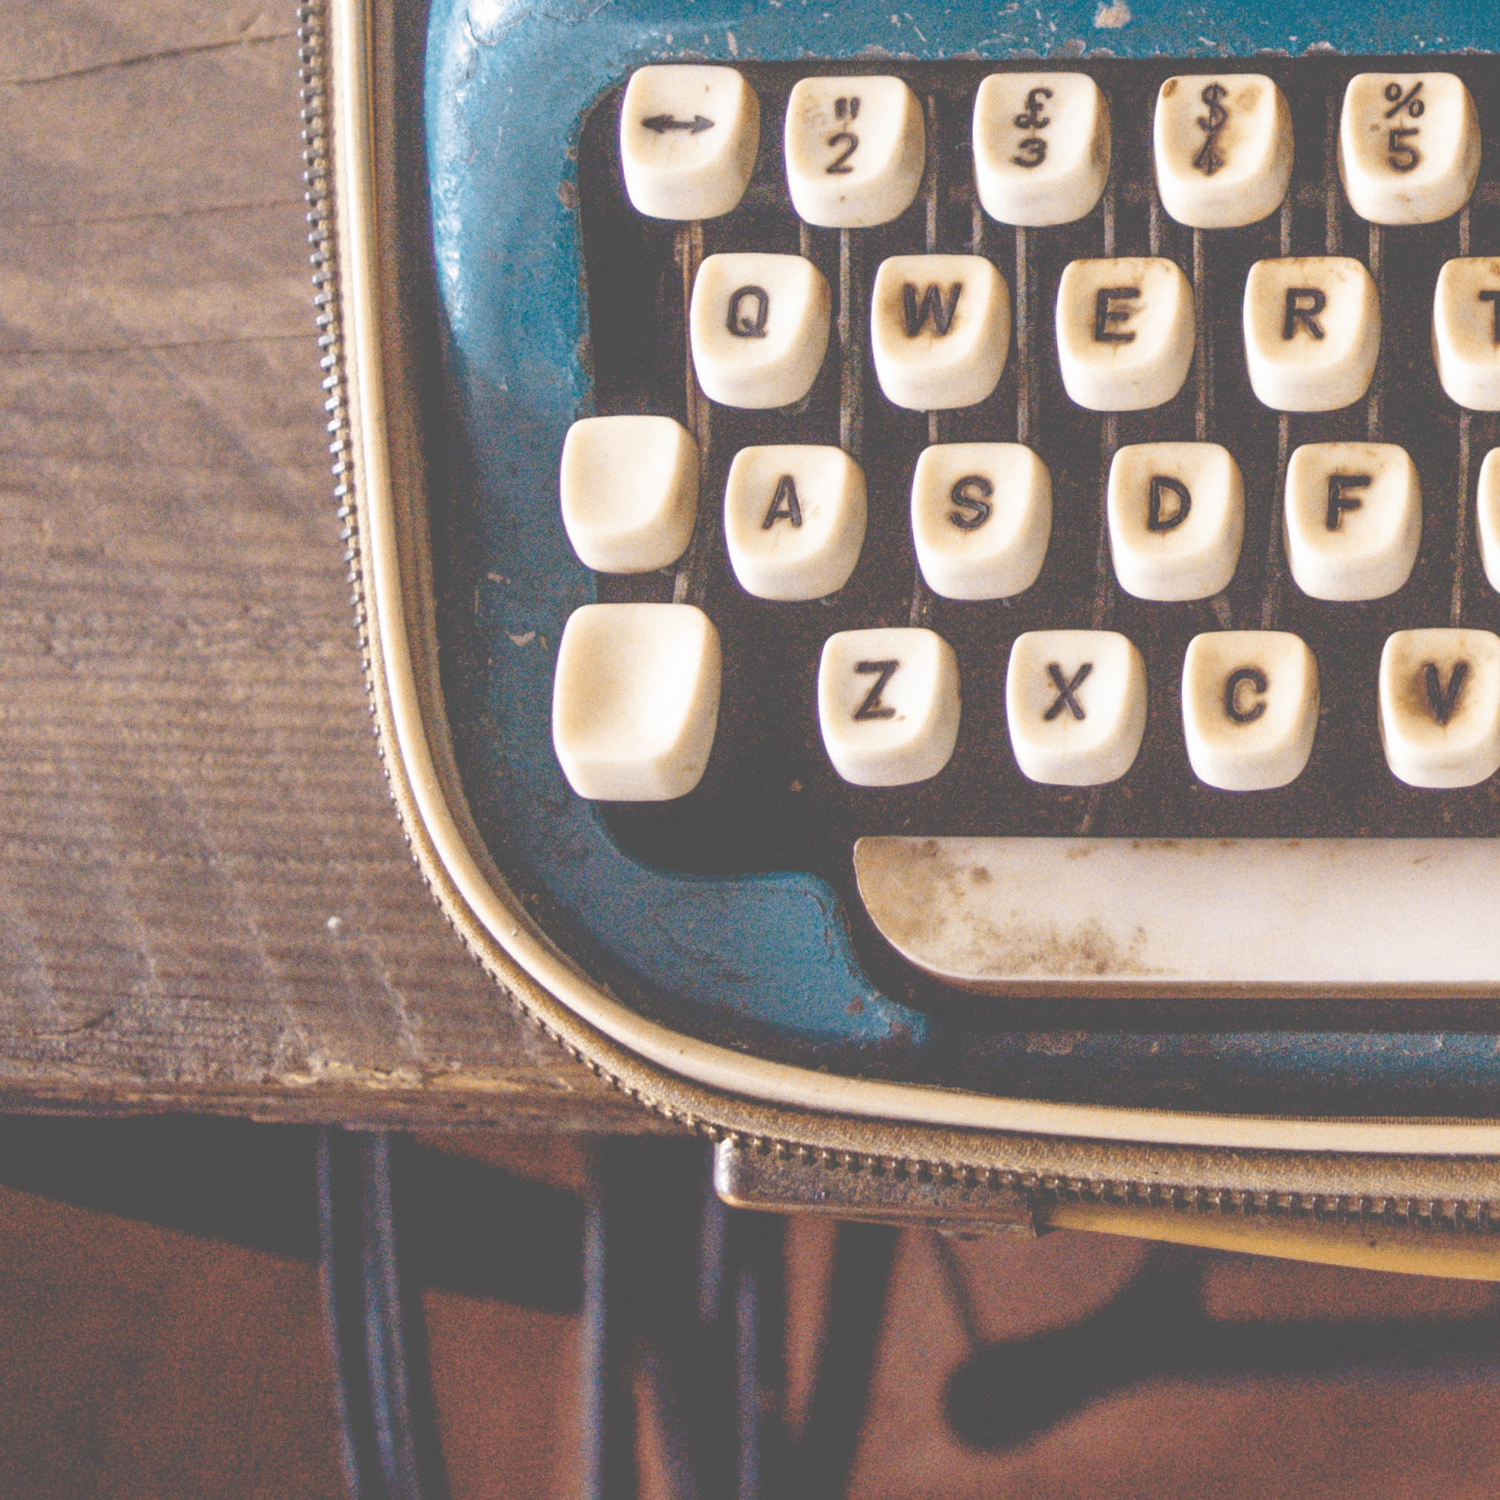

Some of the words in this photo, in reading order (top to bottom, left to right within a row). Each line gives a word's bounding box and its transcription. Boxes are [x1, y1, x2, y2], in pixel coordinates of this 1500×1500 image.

[1014, 87, 1053, 131] £
[1196, 81, 1229, 132] $
[1383, 80, 1427, 120] %
[825, 131, 859, 175] 2
[1012, 137, 1048, 169] 3
[1385, 128, 1421, 172] 5
[725, 284, 771, 340] Q
[900, 281, 964, 339] W
[1092, 285, 1141, 345] E
[1280, 285, 1328, 342] R
[760, 474, 804, 531] A
[949, 474, 994, 530] S
[1146, 475, 1193, 532] D
[1324, 473, 1373, 534] F
[852, 659, 901, 721] Z
[1042, 661, 1094, 722] X
[1222, 666, 1270, 725] C
[1422, 661, 1469, 725] V
